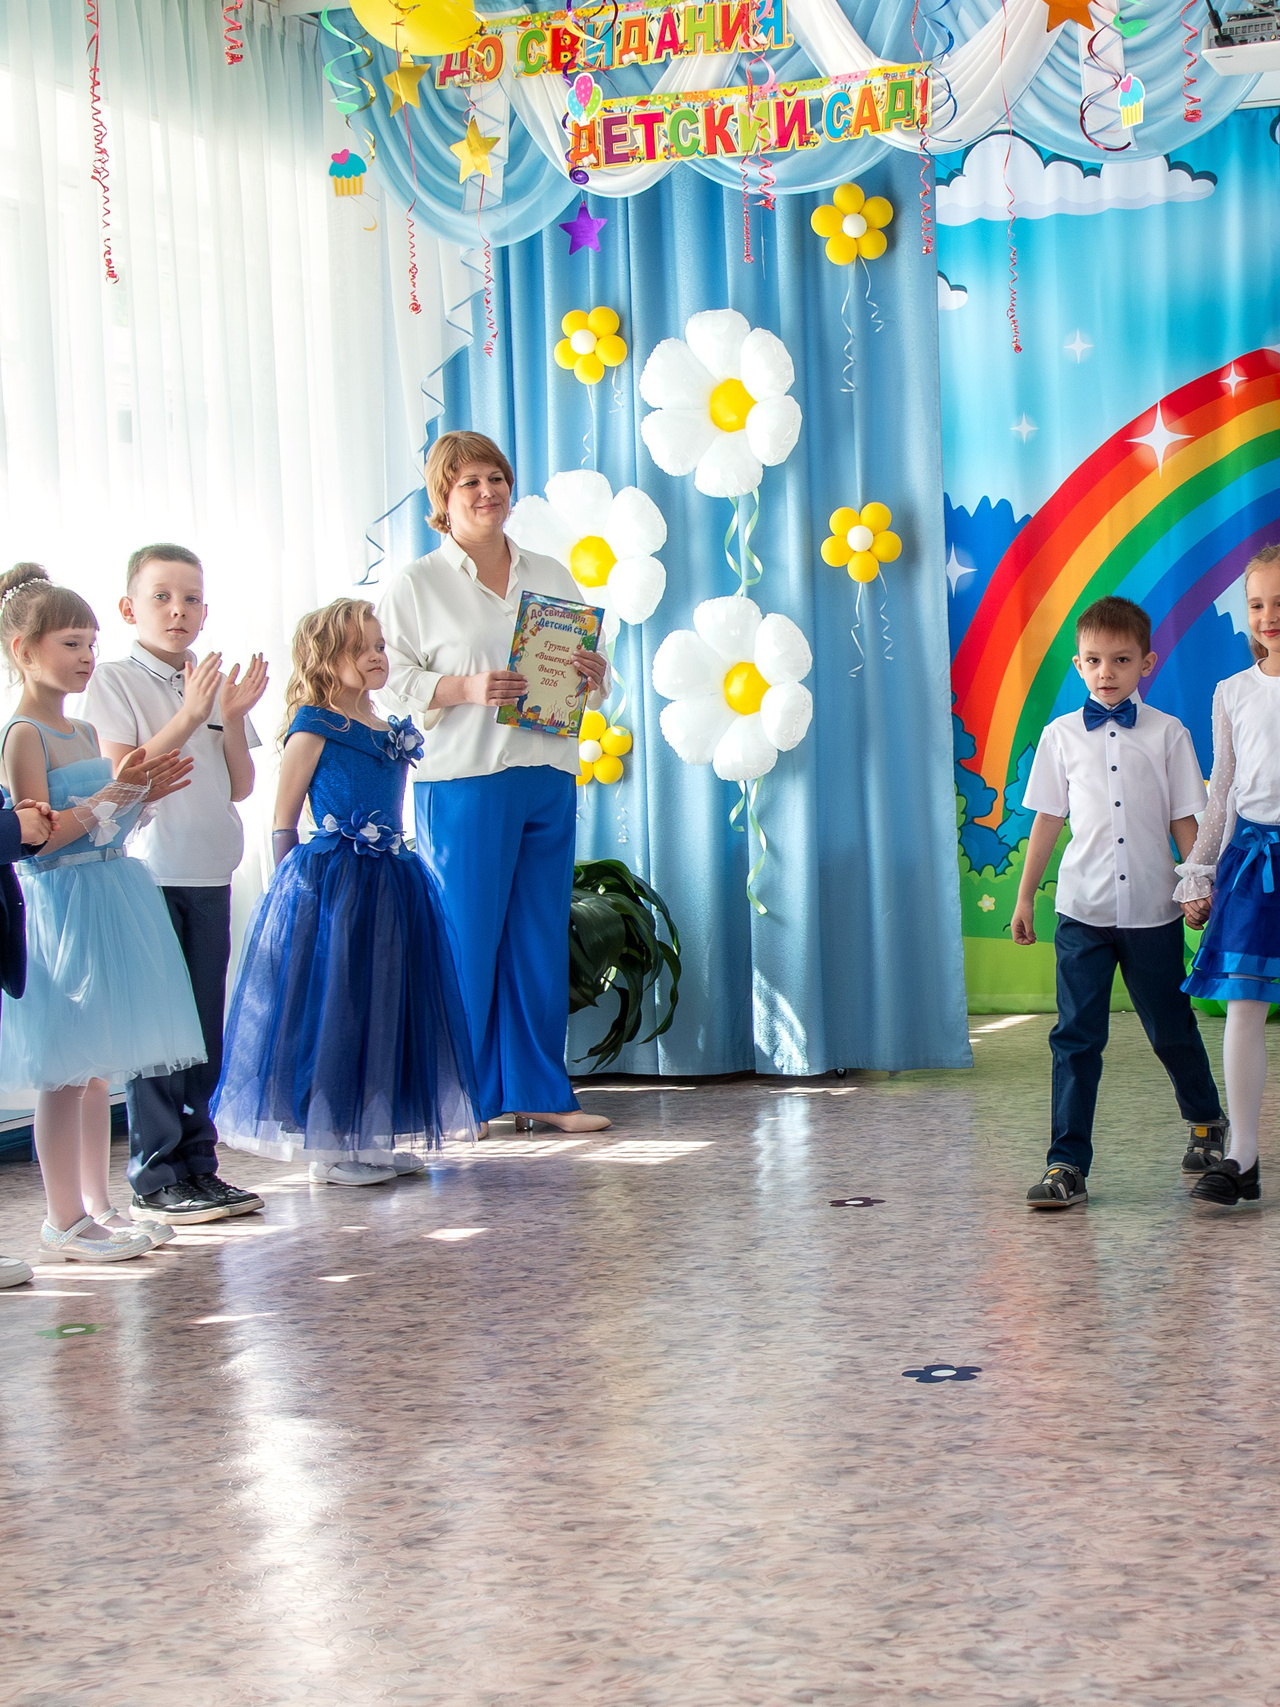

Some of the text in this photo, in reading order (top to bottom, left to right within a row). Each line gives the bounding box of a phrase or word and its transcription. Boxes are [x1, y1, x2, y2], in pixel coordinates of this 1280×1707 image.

[569, 75, 928, 168] ДЕТСКИЙ САД!
[530, 609, 542, 620] До
[573, 627, 588, 637] сад
[544, 640, 570, 652] Группа
[538, 664, 567, 679] Выпуск
[540, 677, 558, 687] 2026
